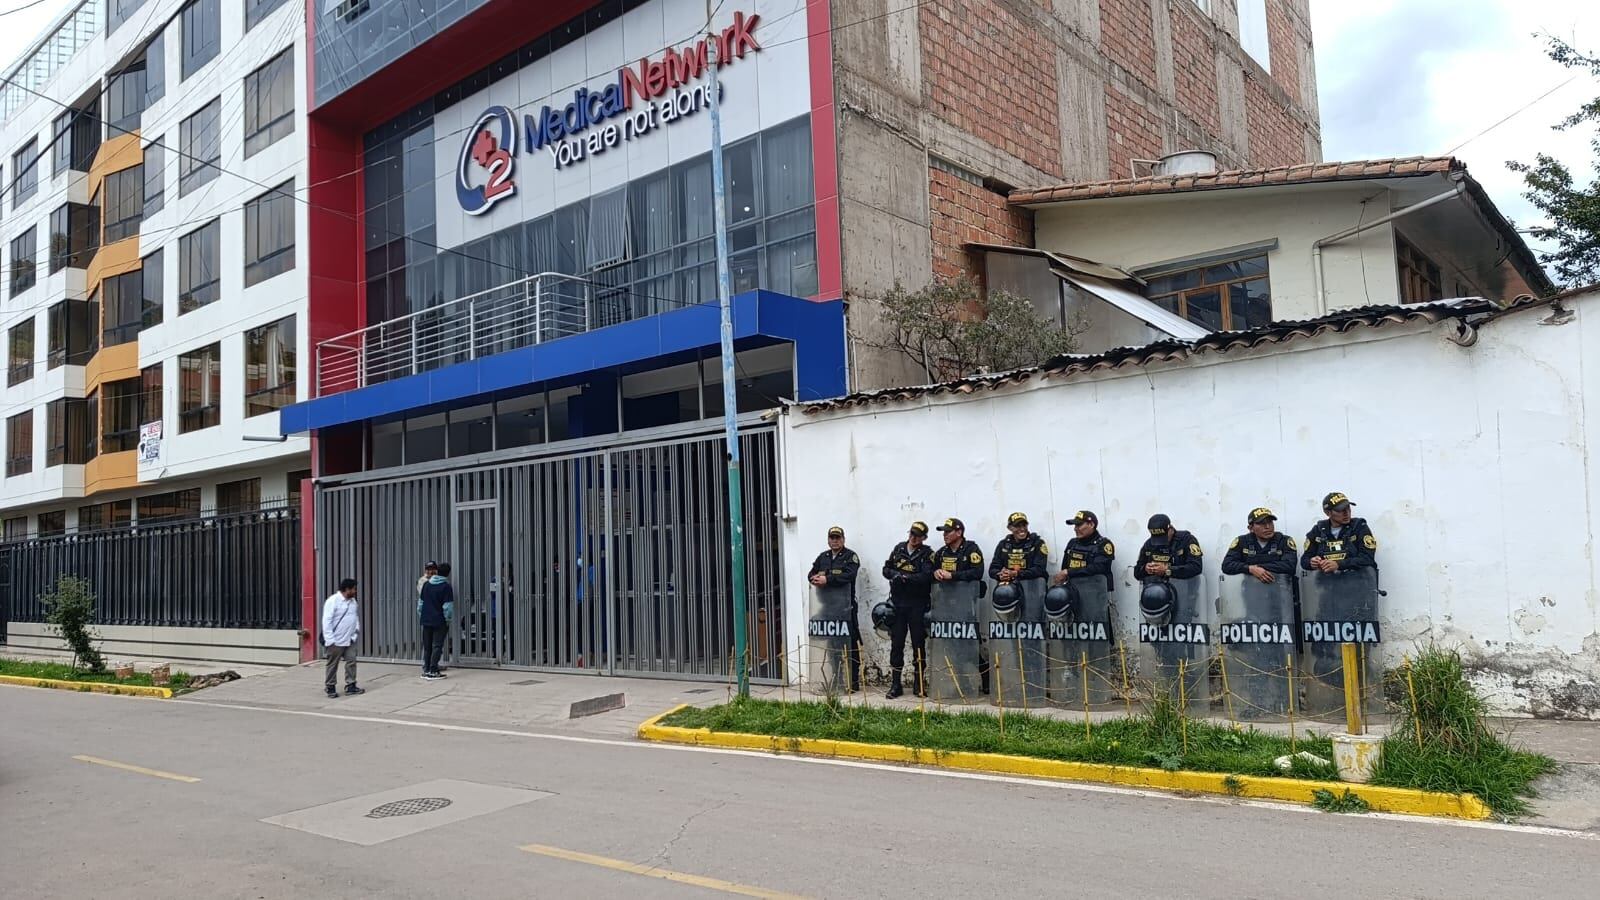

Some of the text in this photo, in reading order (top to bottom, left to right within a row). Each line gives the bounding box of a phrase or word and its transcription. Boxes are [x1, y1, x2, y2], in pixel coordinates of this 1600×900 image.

[548, 138, 584, 170] You
[588, 124, 620, 154] are
[623, 101, 659, 140] not
